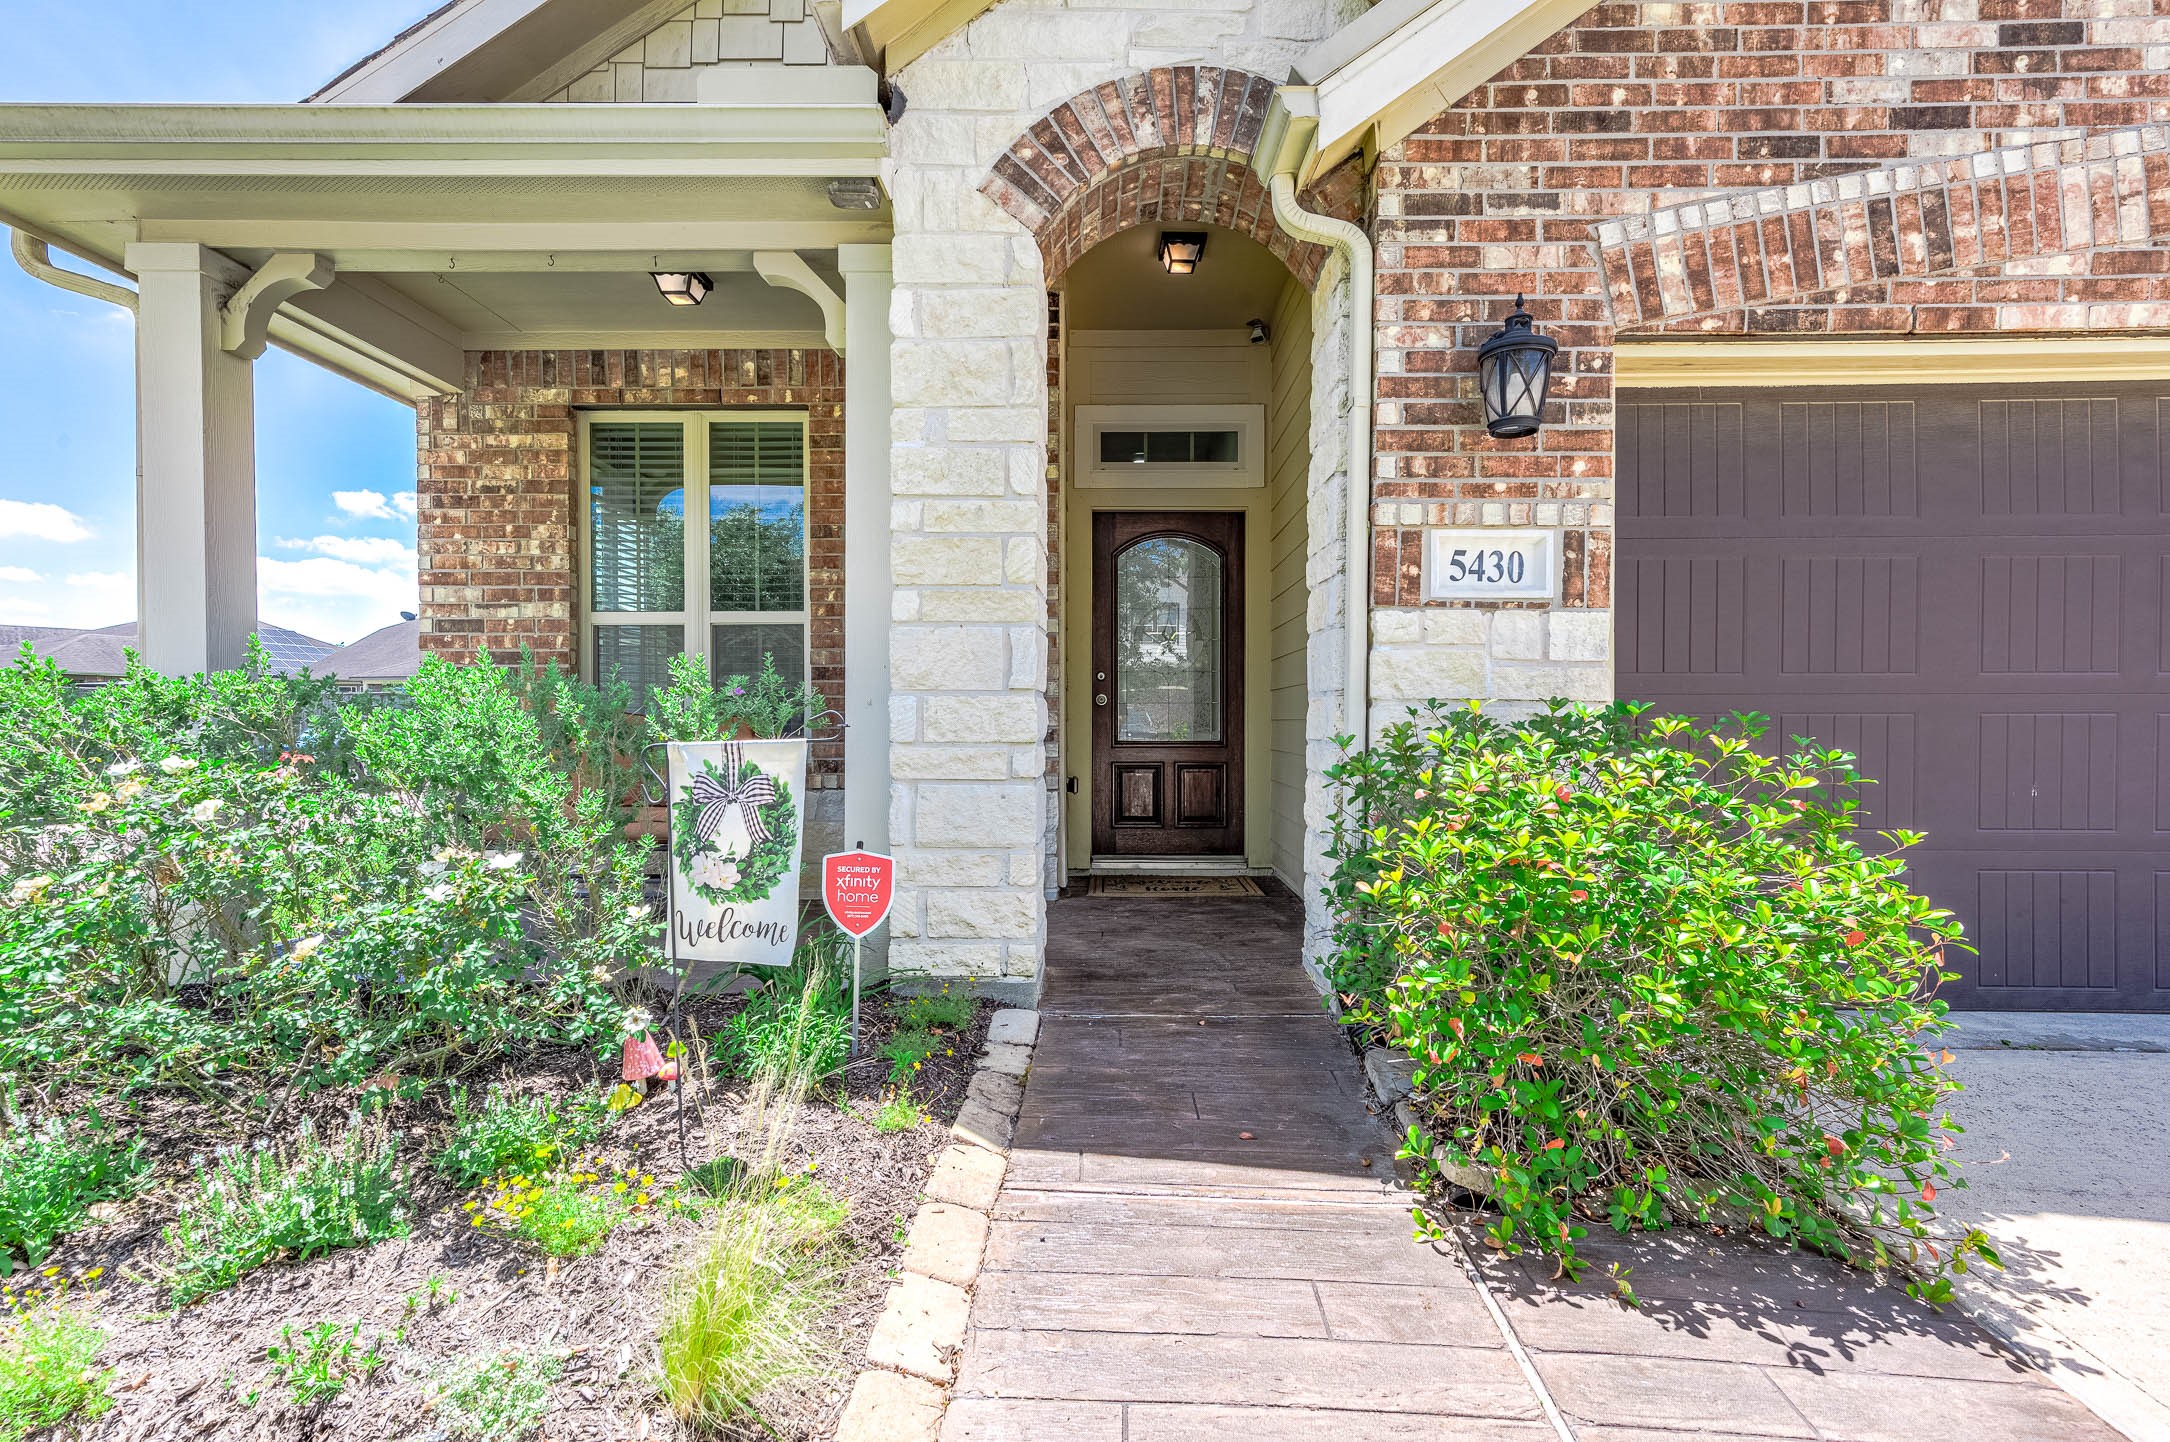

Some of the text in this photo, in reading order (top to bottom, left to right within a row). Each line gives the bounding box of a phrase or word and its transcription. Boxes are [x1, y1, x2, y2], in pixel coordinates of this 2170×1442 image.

[1449, 549, 1525, 584] 5430
[837, 865, 882, 874] SECURED BY
[836, 874, 881, 891] xfinity
[837, 890, 879, 904] home
[676, 907, 790, 948] Welcome
